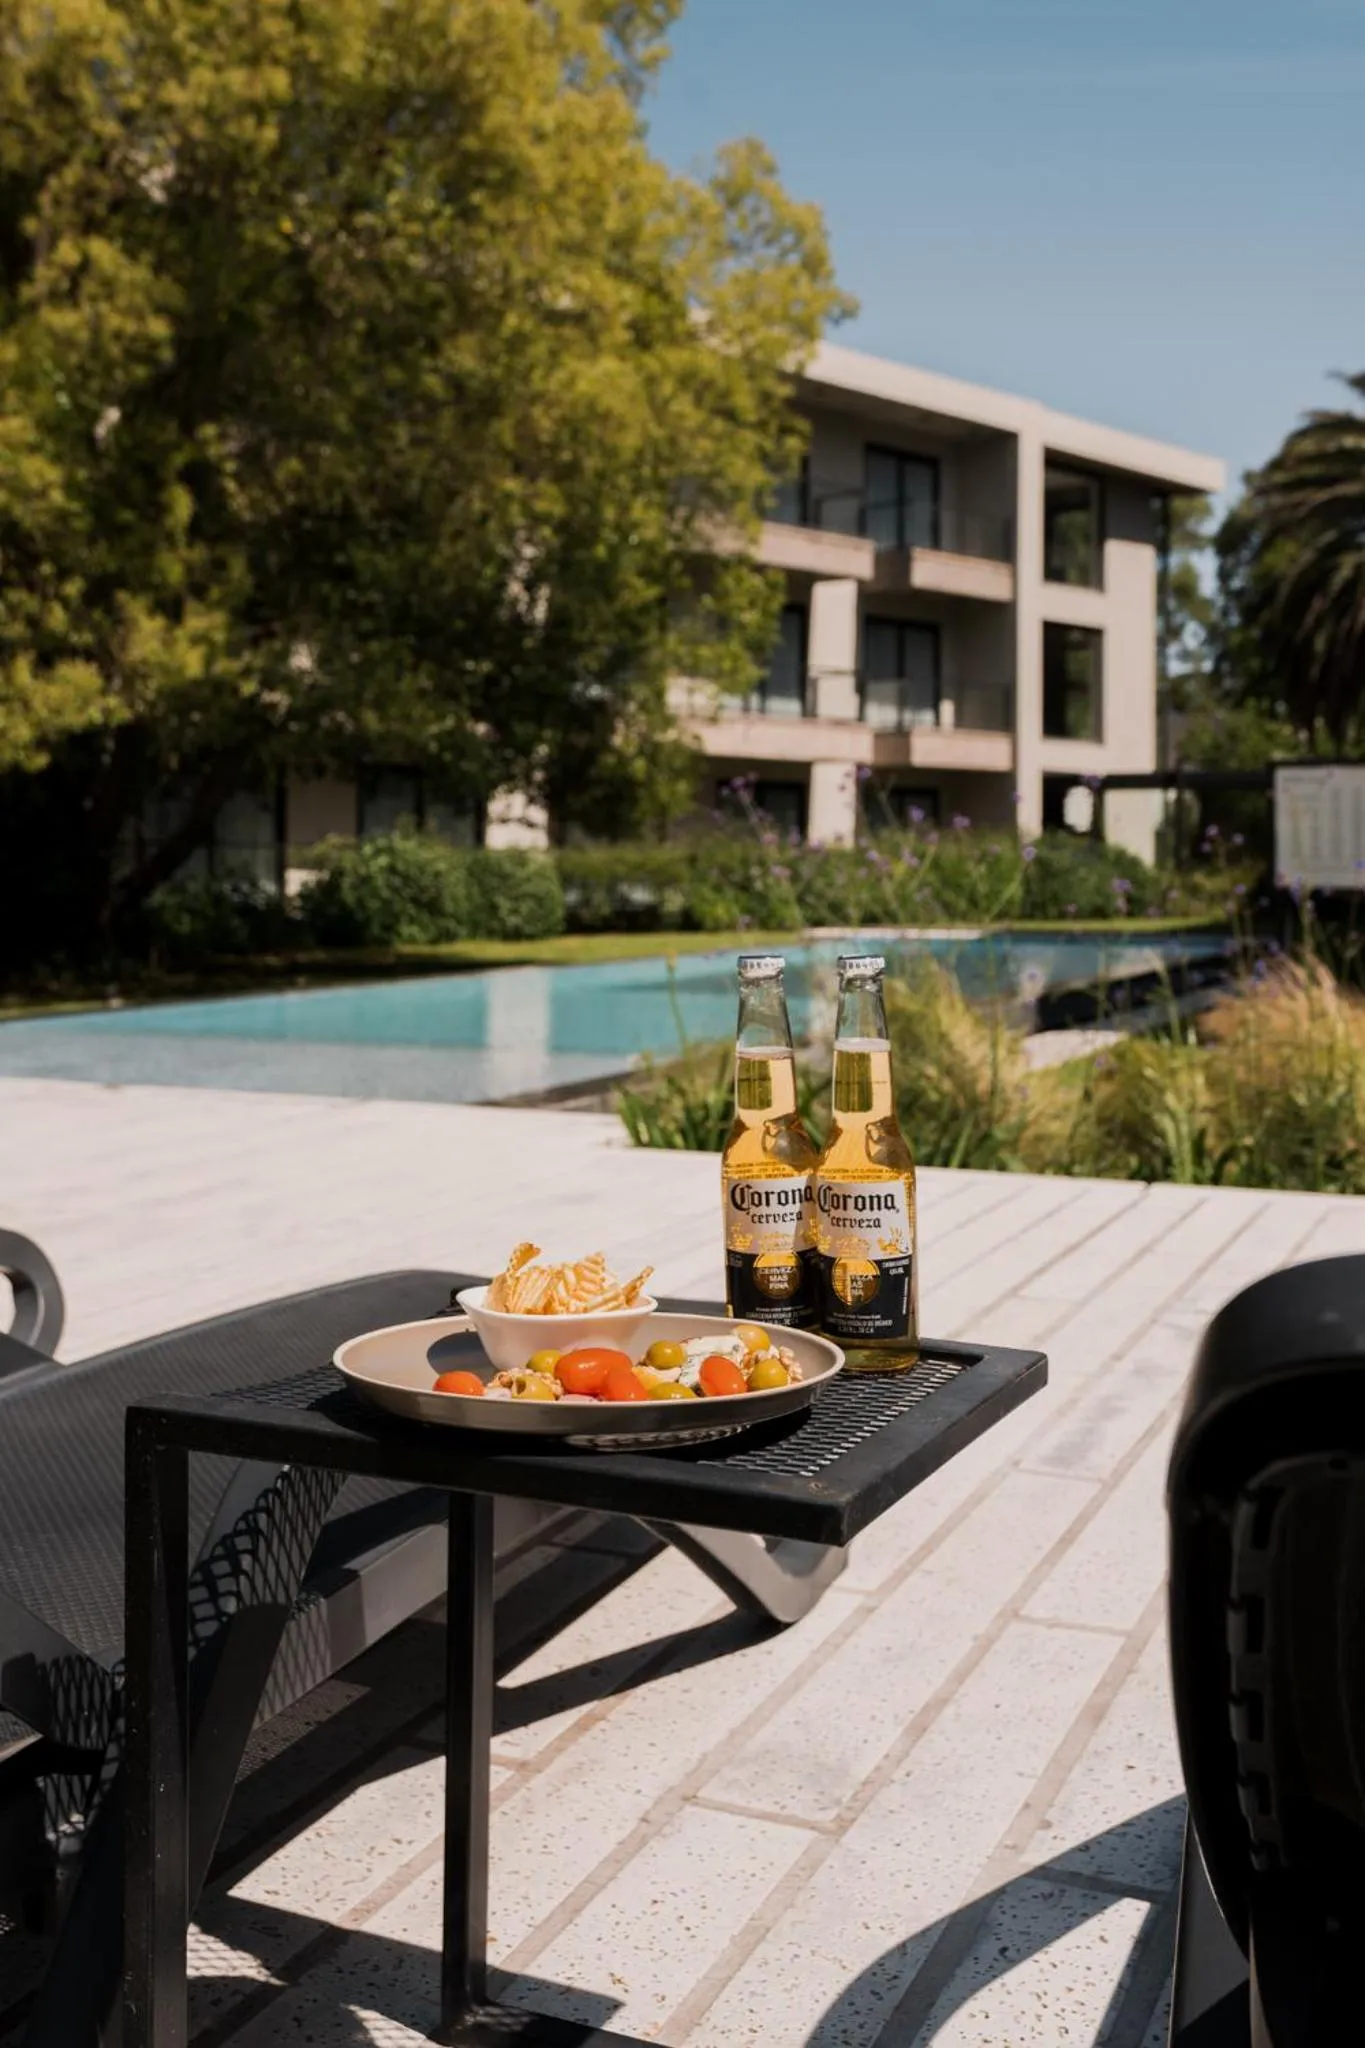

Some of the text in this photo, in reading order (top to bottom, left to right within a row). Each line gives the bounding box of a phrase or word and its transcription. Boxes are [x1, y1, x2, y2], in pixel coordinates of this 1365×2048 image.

[731, 1183, 814, 1212] Corona
[817, 1184, 897, 1214] Corona
[751, 1211, 803, 1225] cerveza
[830, 1216, 882, 1229] cerveza
